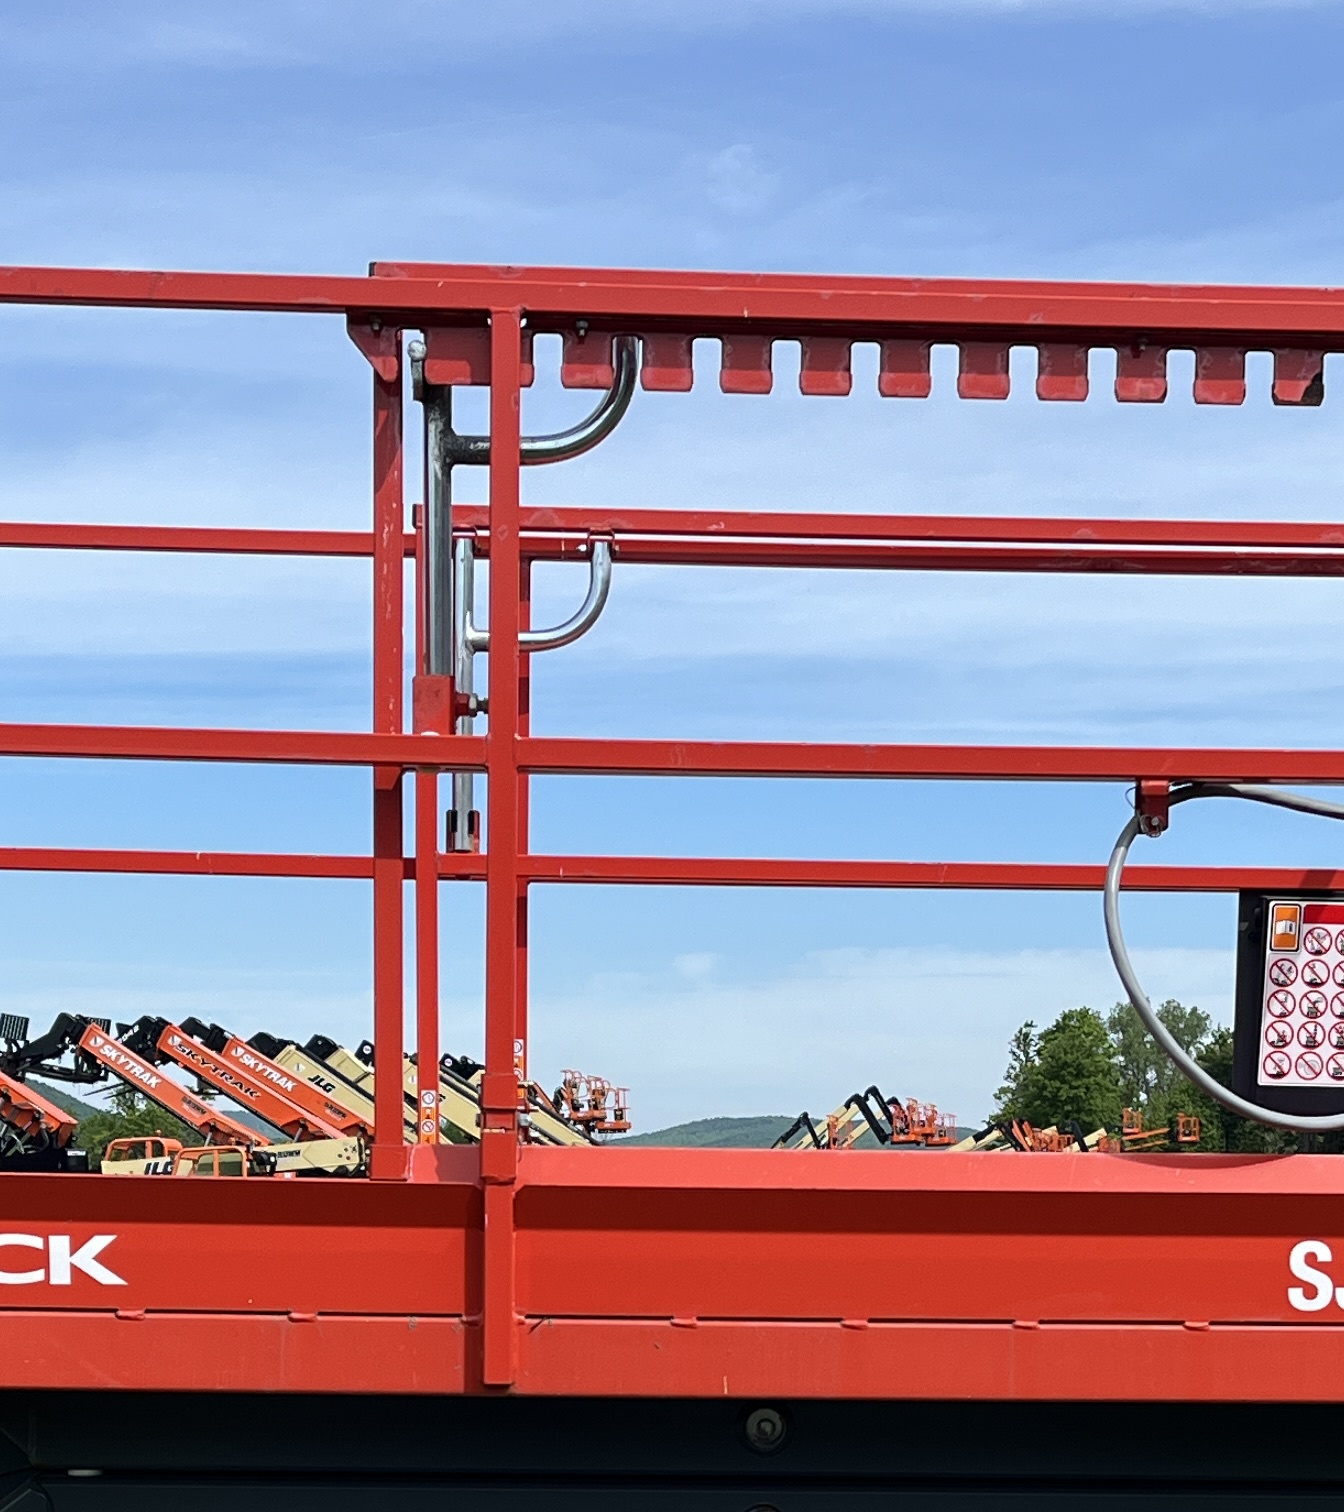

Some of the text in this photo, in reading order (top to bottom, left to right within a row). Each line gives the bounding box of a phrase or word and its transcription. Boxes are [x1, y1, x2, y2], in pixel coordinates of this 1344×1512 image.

[99, 1041, 163, 1088] SKYTRAK
[175, 1043, 261, 1099] SKYTRAK
[239, 1053, 298, 1092] SKYTRAK
[308, 1074, 336, 1093] JLG
